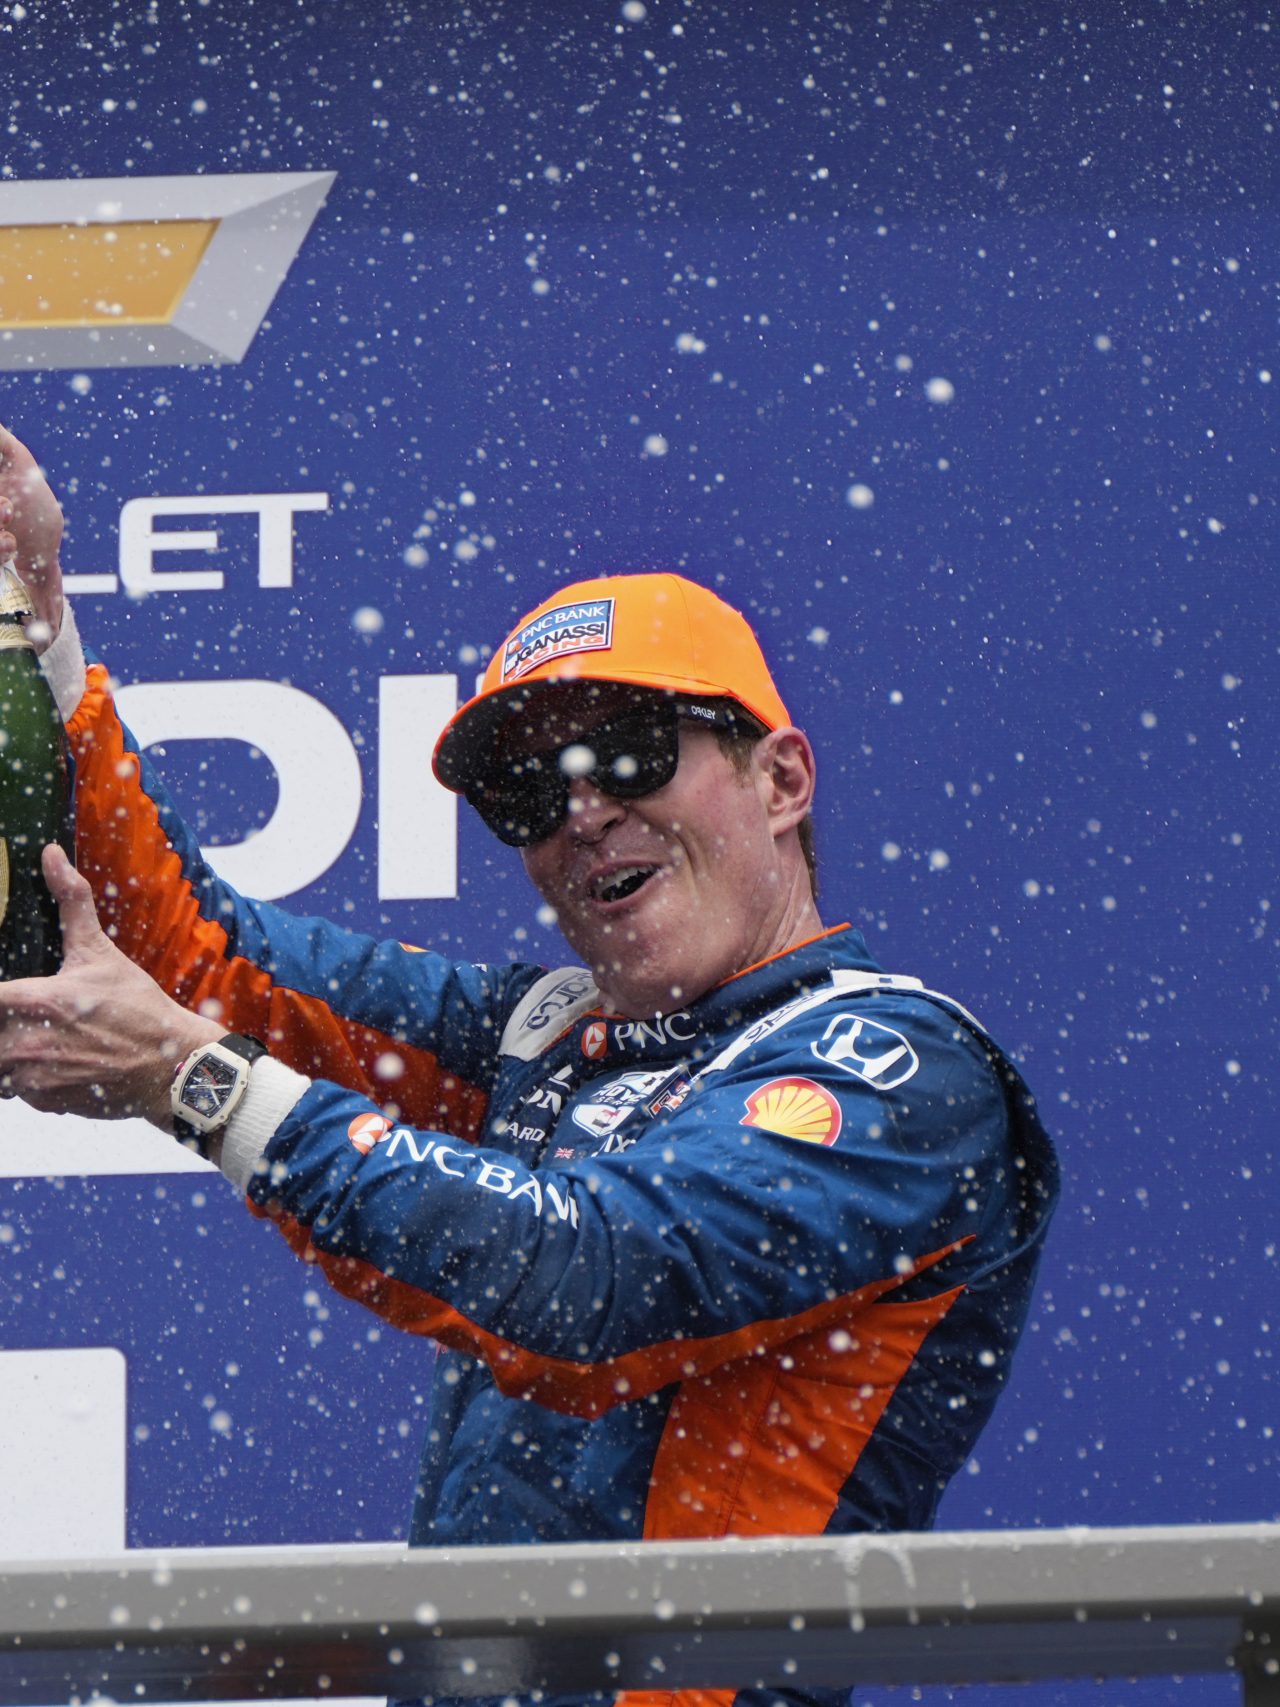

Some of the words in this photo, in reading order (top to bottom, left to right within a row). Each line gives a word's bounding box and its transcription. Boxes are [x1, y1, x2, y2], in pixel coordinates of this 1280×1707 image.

[521, 616, 552, 643] PNC
[554, 606, 605, 624] BANK
[614, 1012, 696, 1050] PNC
